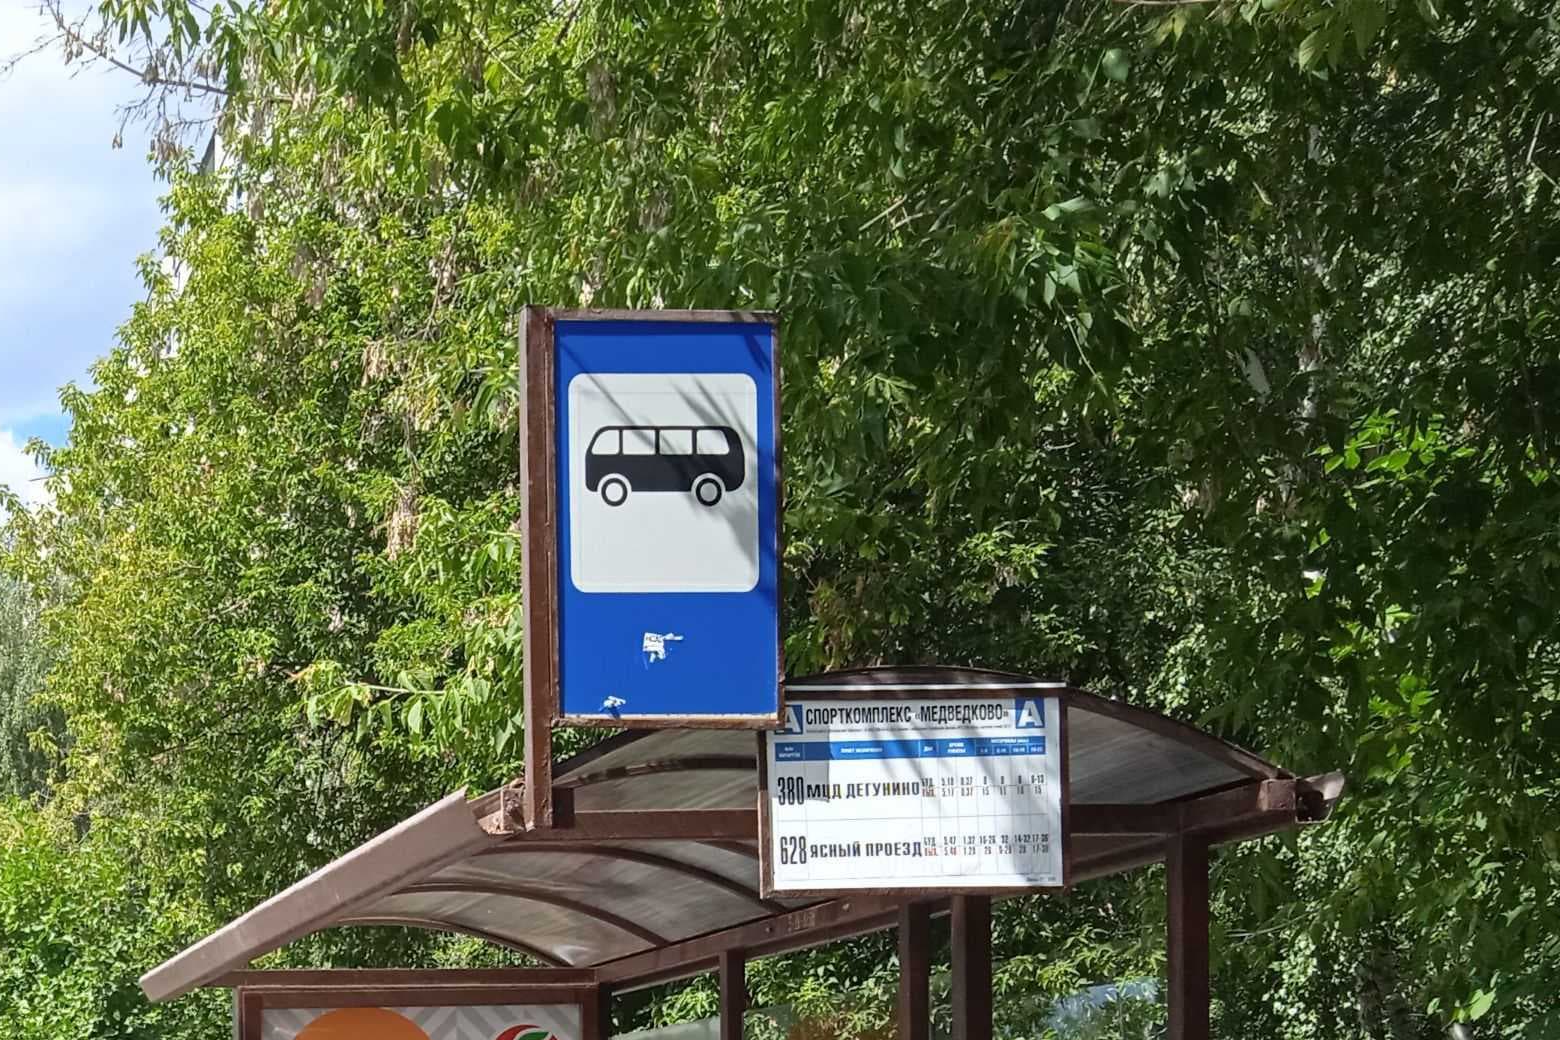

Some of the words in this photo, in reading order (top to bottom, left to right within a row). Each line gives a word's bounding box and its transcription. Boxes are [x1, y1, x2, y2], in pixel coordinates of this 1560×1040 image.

[806, 705, 911, 725] СПОРТКОМПЛЕКС
[915, 703, 1009, 724] «МЕДВЕДКОВО»
[777, 776, 805, 806] 380
[807, 783, 842, 800] МЦД
[846, 781, 920, 799] ДЕГУНИНО
[779, 835, 808, 865] 628
[810, 840, 861, 858] ЯСНЫЙ
[866, 841, 922, 857] ПРОЕЗД
